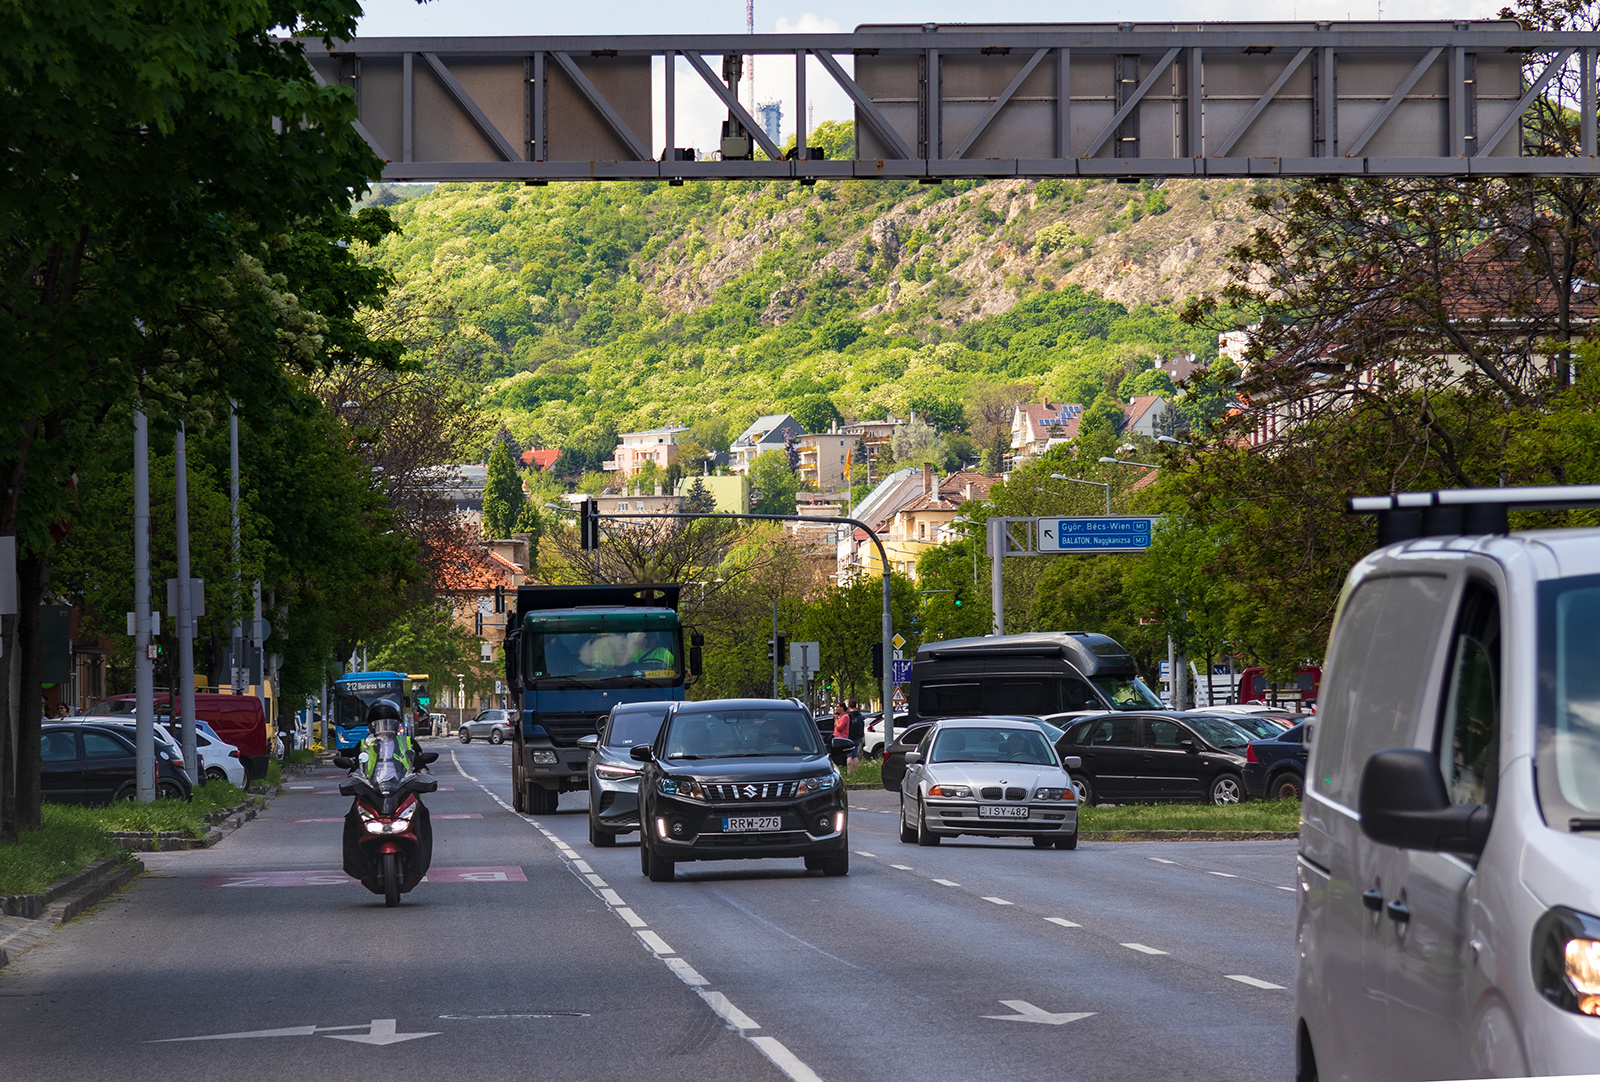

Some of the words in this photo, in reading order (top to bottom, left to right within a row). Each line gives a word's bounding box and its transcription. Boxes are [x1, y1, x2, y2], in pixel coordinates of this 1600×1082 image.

[1093, 536, 1131, 546] Nagykanizsa
[346, 682, 358, 691] 212
[989, 807, 1027, 816] ISY-482
[730, 817, 779, 829] RRW-276
